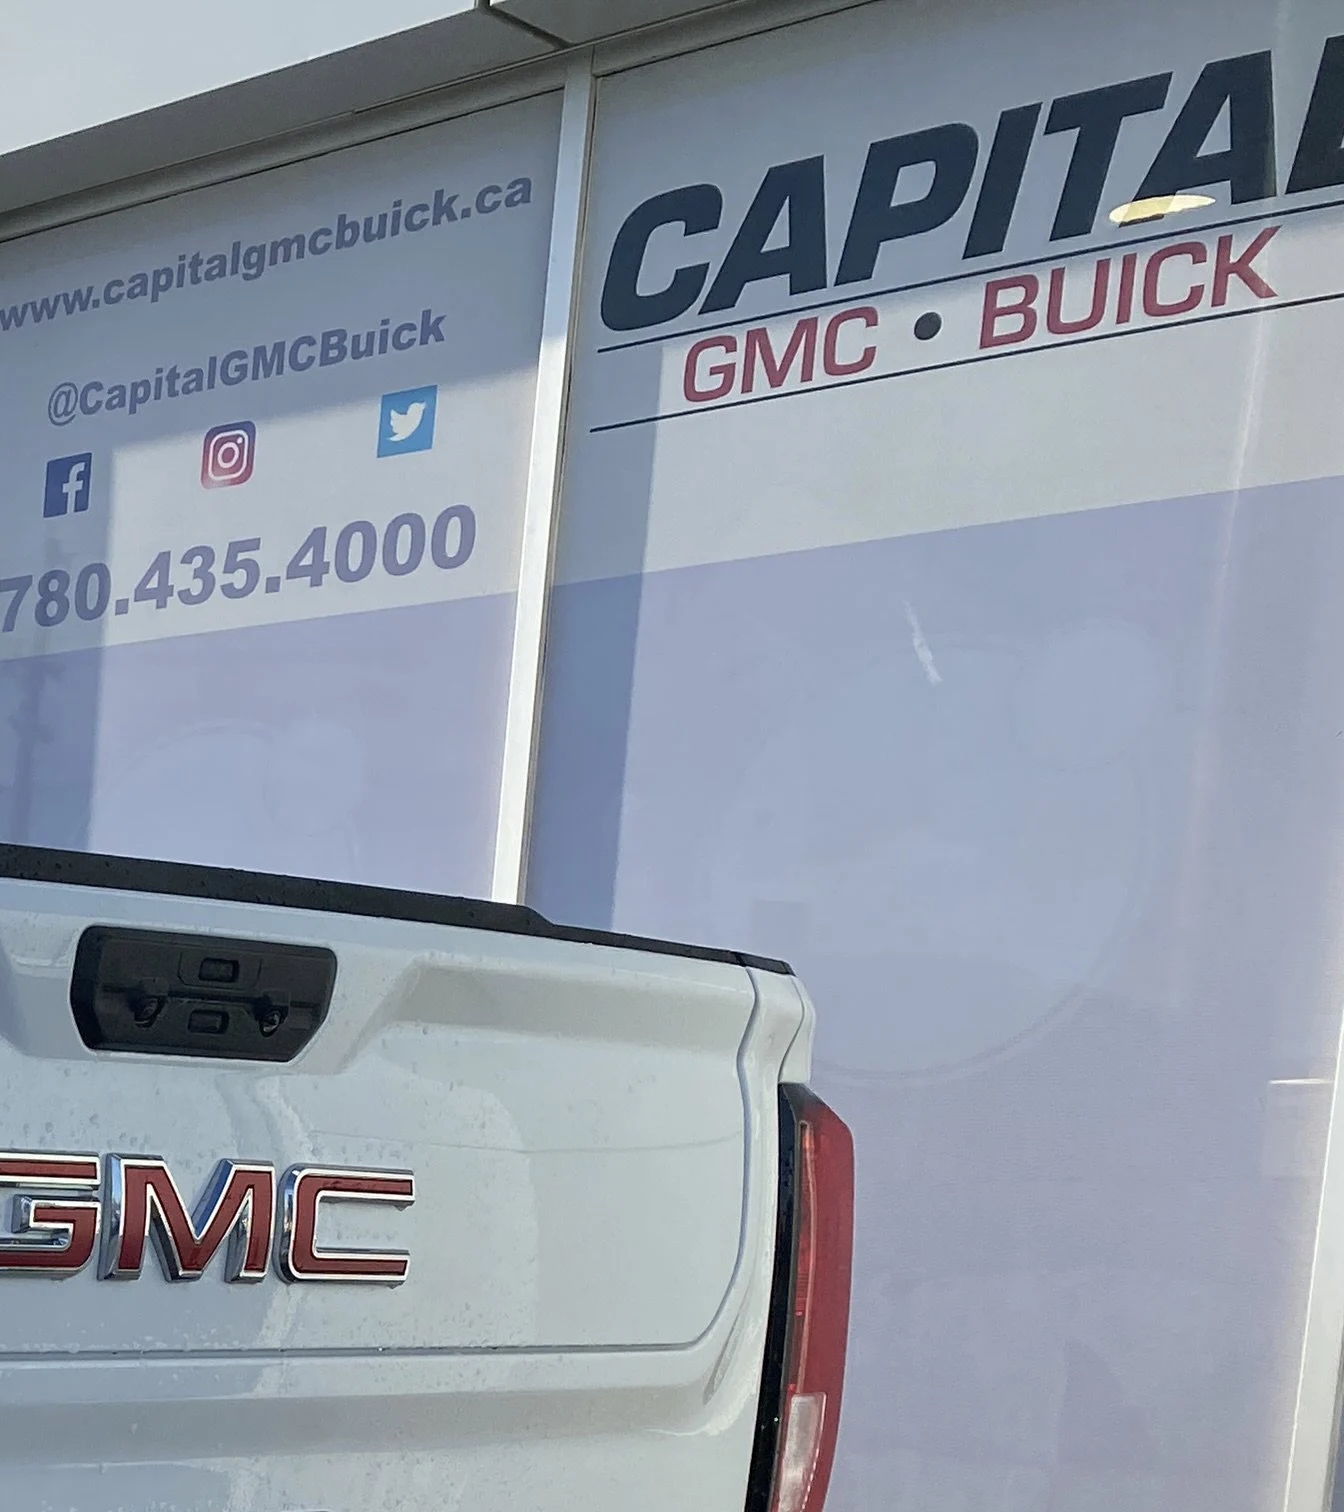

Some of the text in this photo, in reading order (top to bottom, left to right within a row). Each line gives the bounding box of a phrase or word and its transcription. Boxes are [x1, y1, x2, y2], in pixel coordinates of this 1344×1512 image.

[47, 308, 446, 426] @CapitalGMCBuick
[683, 225, 1279, 403] GMC BUICK
